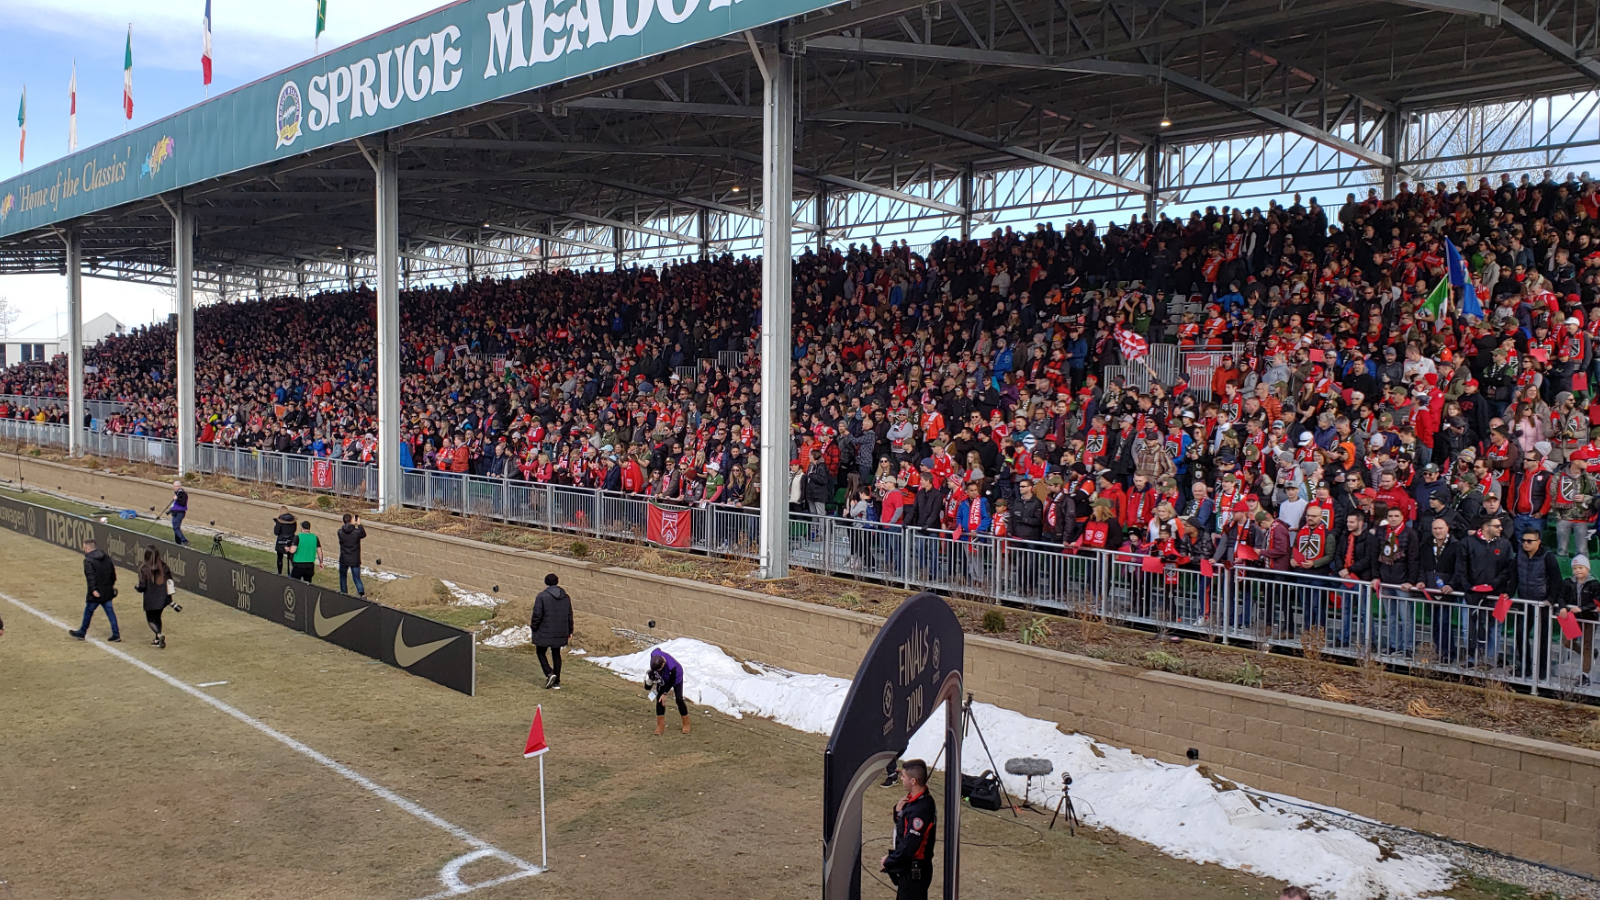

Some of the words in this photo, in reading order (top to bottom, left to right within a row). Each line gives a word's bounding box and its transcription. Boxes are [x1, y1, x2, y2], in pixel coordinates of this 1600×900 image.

[307, 25, 463, 131] SPRUCE
[484, 0, 743, 79] MEAD
[50, 171, 62, 212] of
[62, 168, 80, 199] the
[46, 511, 95, 549] macron
[231, 567, 256, 594] FINALS
[237, 592, 251, 611] 2019
[899, 621, 929, 687] FINALS
[906, 684, 924, 733] 2019
